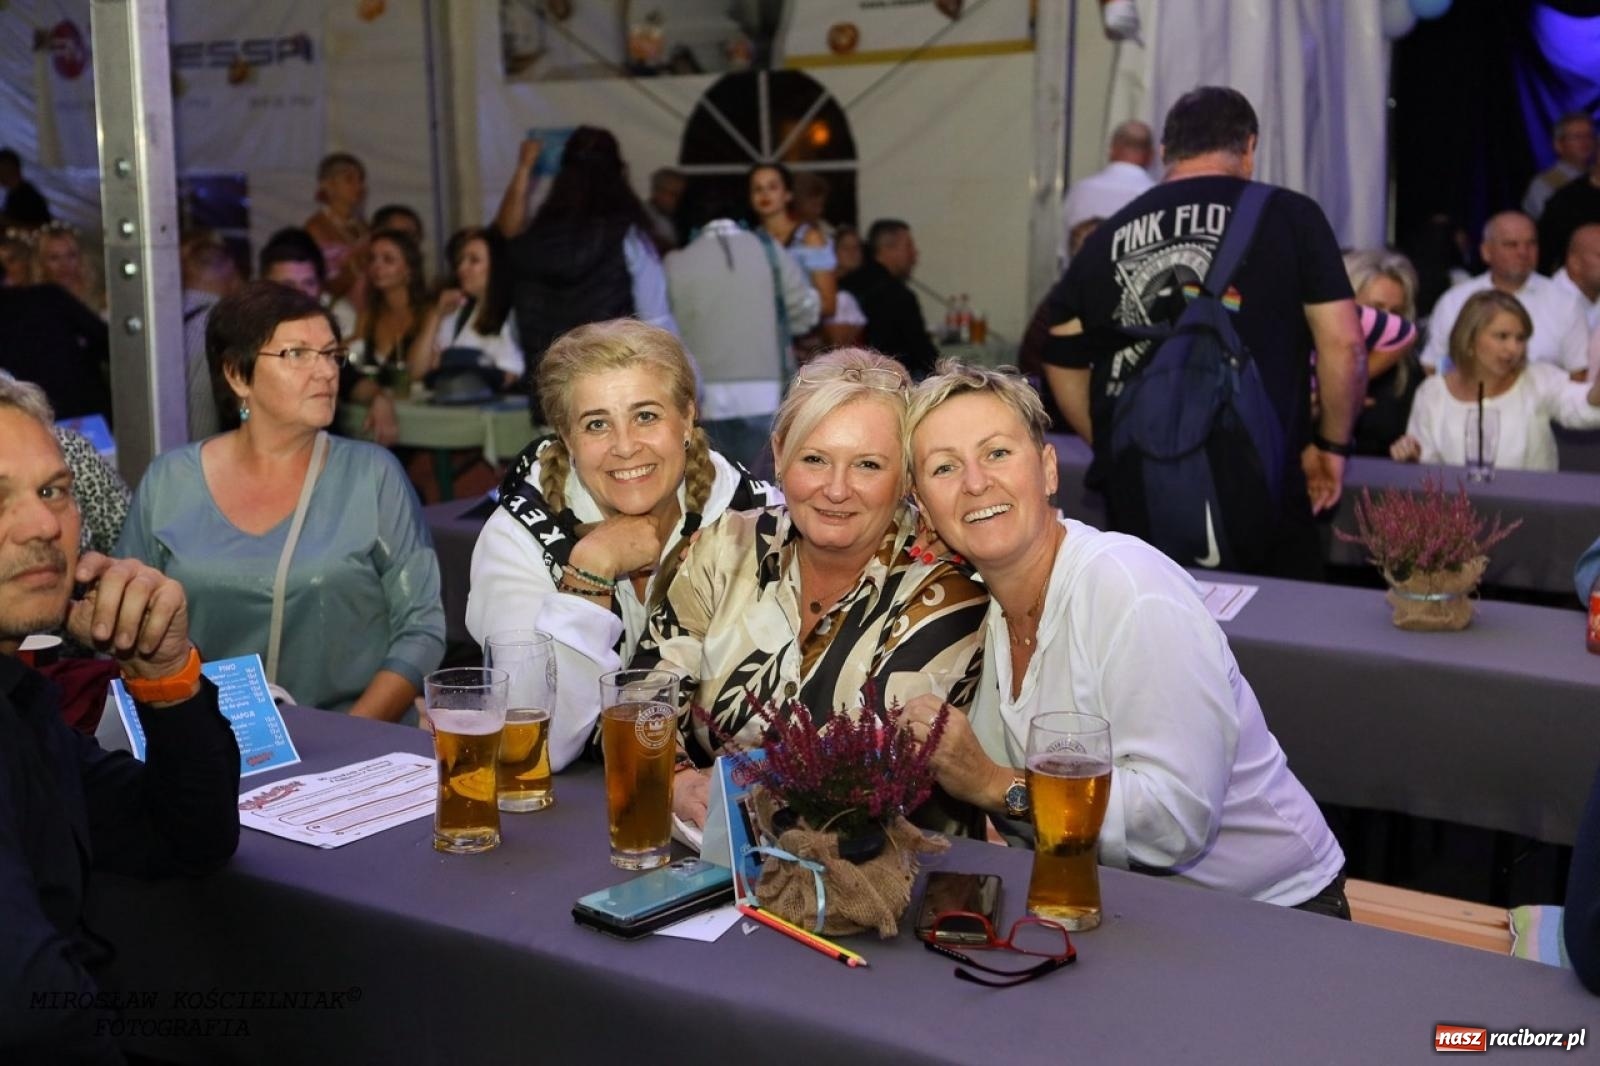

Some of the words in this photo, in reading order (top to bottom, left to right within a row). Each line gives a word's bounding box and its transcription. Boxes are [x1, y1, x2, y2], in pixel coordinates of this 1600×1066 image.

[171, 32, 314, 69] ESSA
[1111, 210, 1166, 261] PINK
[1174, 203, 1231, 237] FLO
